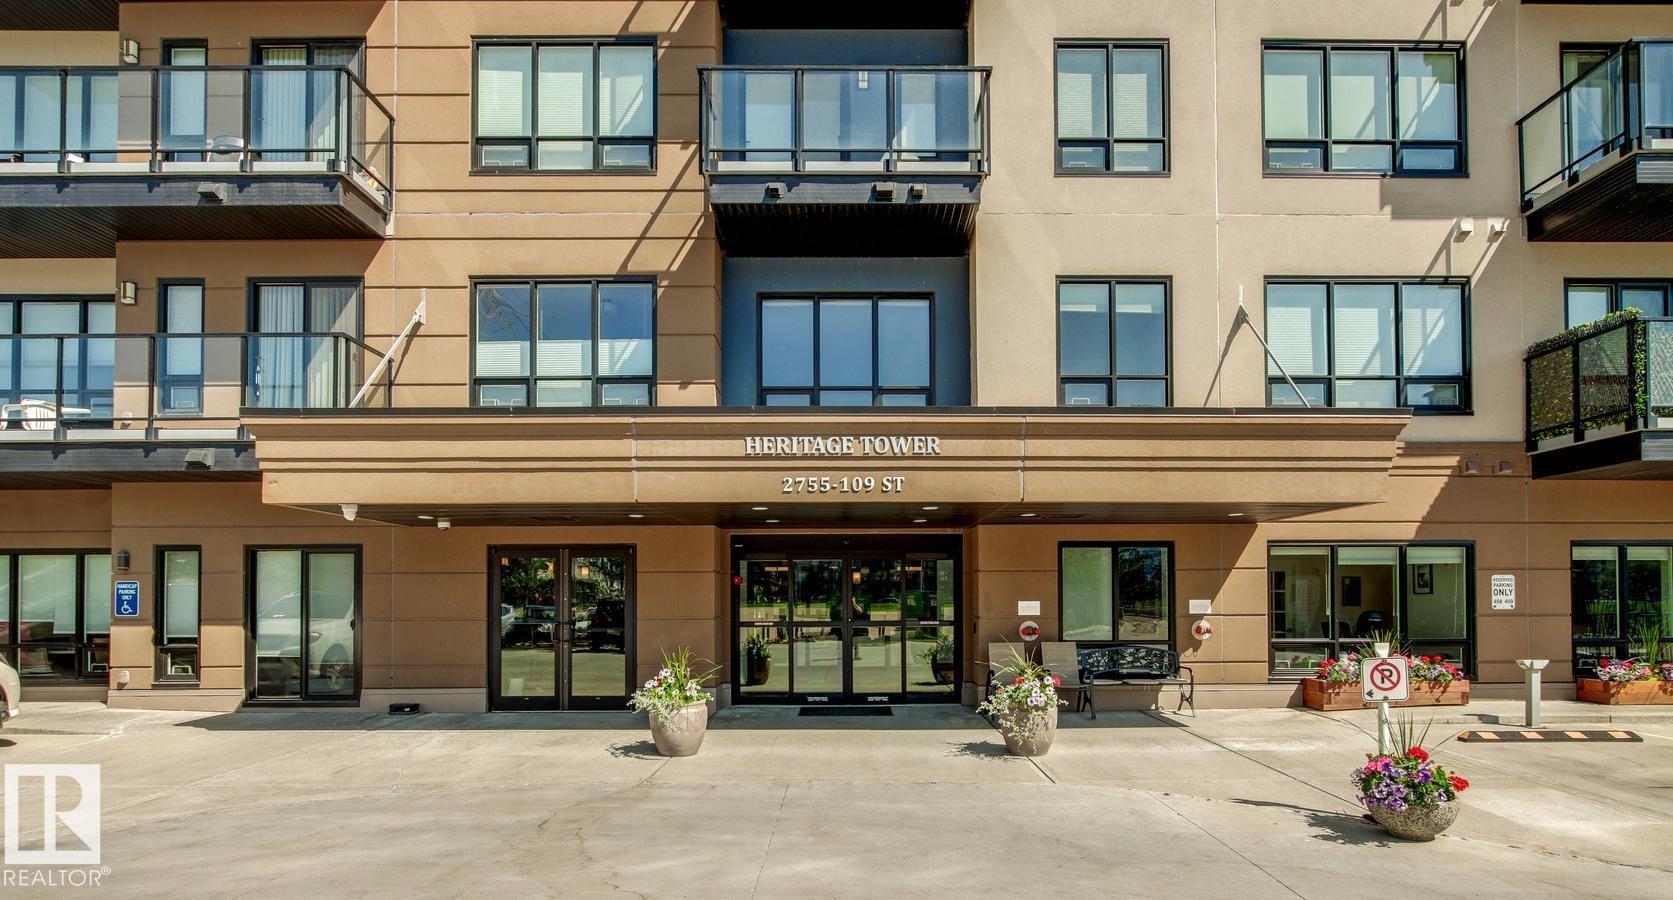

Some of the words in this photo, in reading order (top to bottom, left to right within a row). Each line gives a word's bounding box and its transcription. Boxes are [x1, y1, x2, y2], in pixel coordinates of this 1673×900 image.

[745, 436, 854, 455] HERITAGE
[859, 436, 941, 455] TOWER
[782, 477, 875, 493] 2755-109
[882, 476, 905, 492] ST
